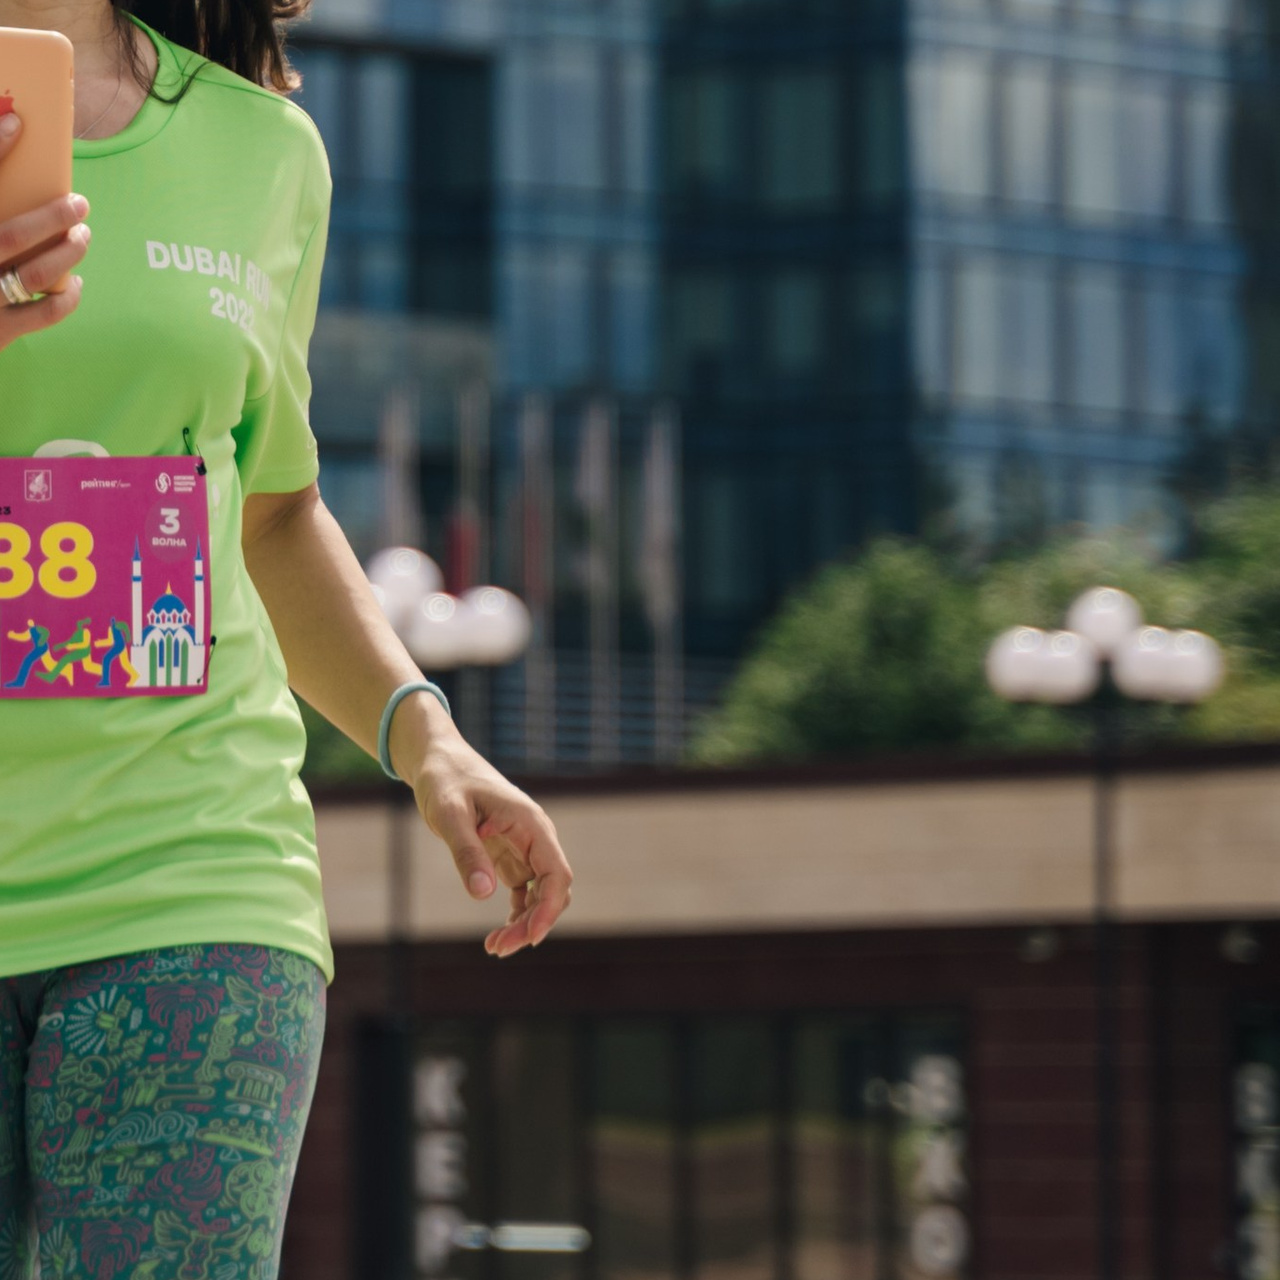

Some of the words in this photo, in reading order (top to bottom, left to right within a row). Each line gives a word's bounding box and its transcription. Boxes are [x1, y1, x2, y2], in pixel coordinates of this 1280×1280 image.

[146, 240, 241, 285] DUBAI
[159, 508, 180, 535] 3
[152, 536, 187, 547] ВОЛНА
